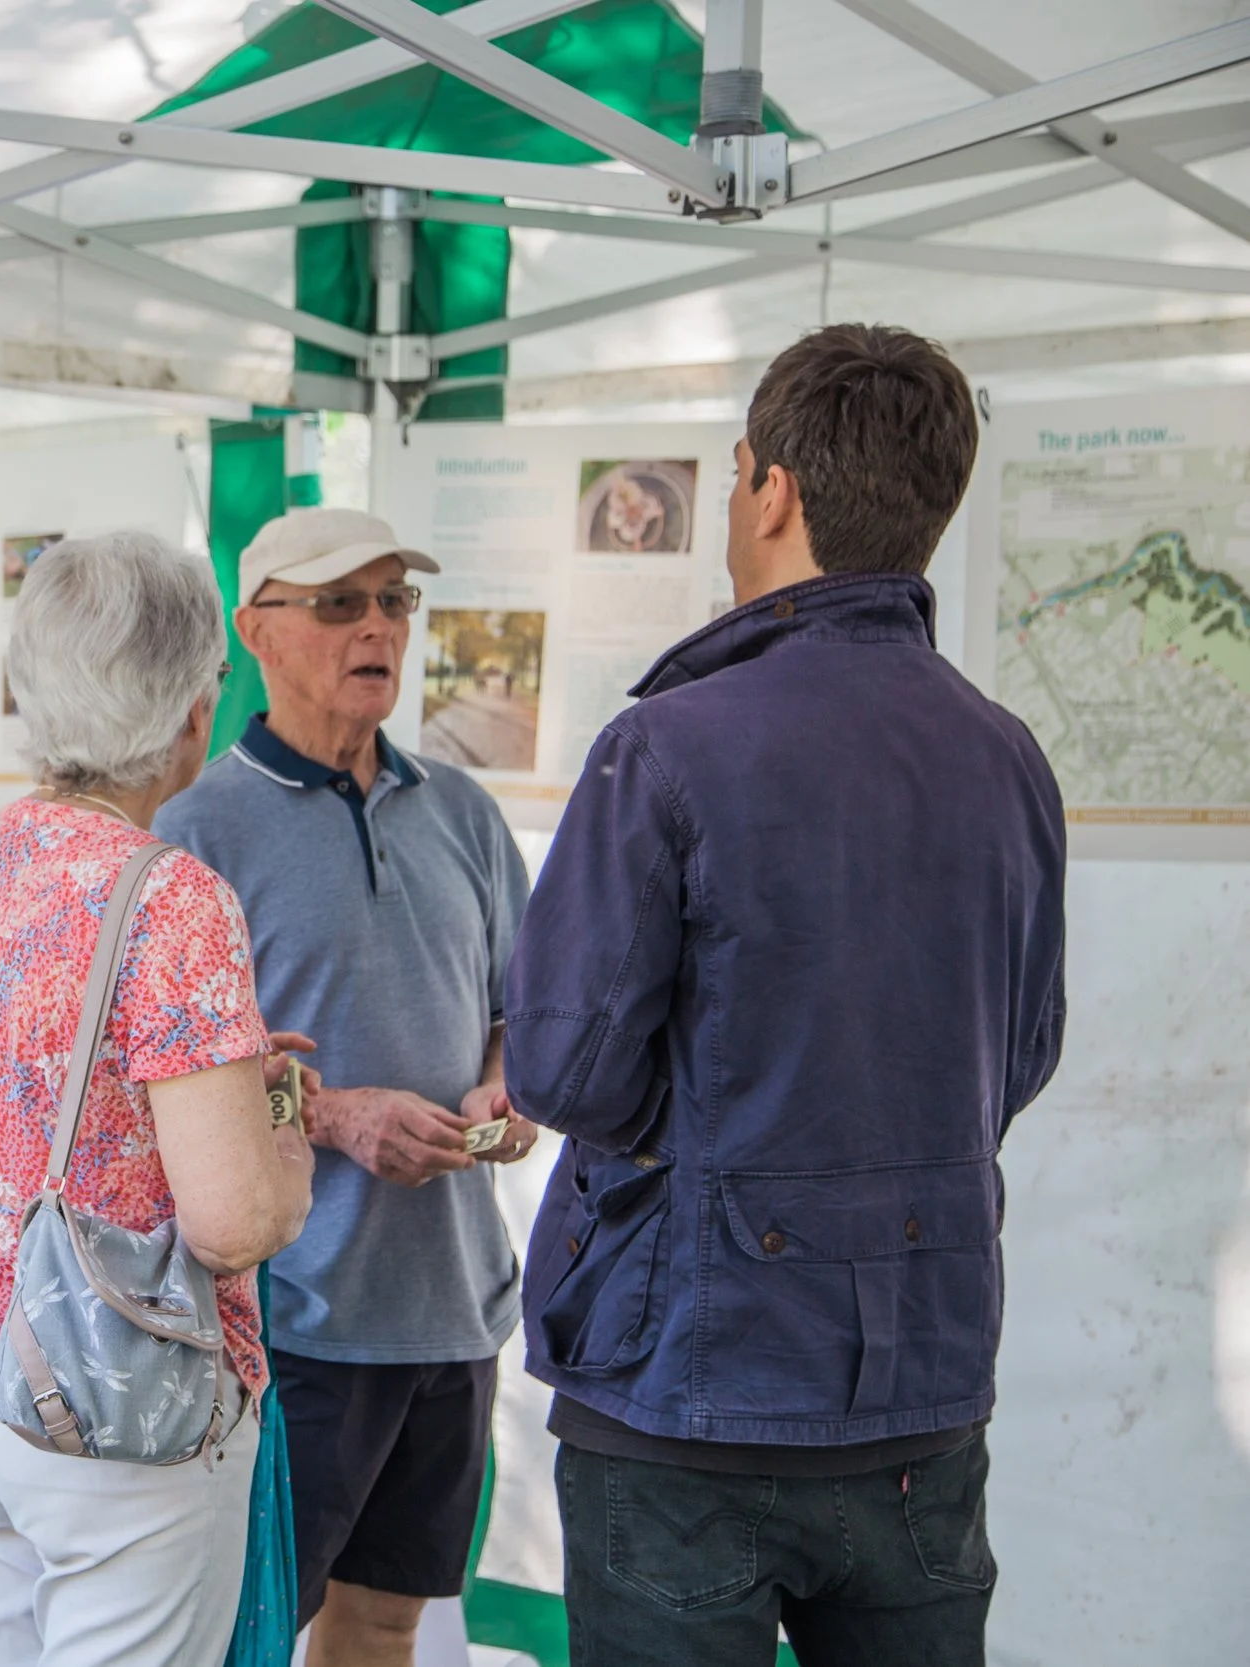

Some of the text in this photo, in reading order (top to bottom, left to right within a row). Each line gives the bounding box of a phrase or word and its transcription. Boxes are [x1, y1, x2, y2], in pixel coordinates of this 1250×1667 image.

[1037, 425, 1185, 453] The park now...
[270, 1093, 286, 1122] 100
